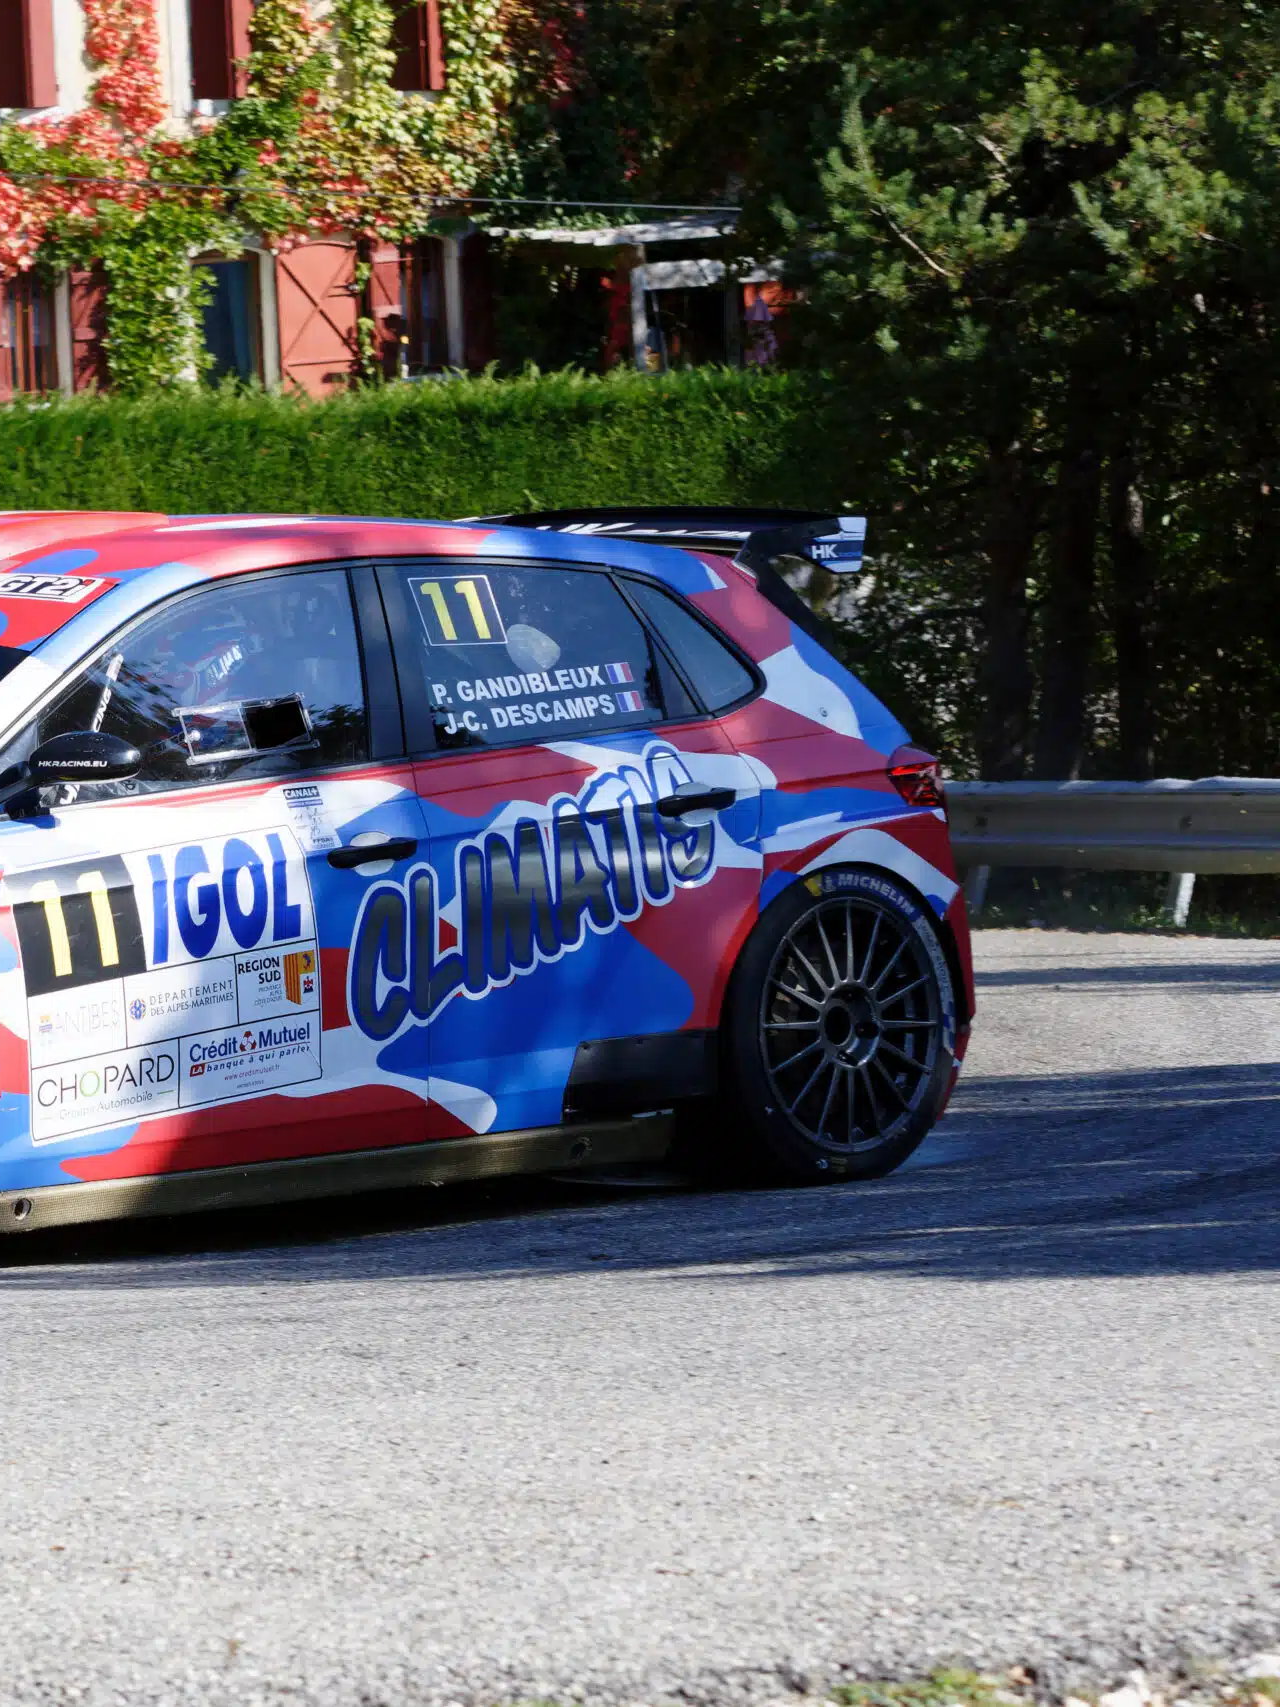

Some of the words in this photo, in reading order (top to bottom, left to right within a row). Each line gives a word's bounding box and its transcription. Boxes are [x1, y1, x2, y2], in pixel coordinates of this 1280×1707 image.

[811, 543, 839, 560] HK
[420, 579, 492, 641] 11
[432, 683, 453, 705] P.
[456, 665, 607, 702] GANDIBLEUX
[444, 712, 489, 735] J-C.
[490, 694, 616, 729] DESCAMPS
[38, 759, 108, 769] HKRACING.EU
[284, 787, 318, 799] CANAL+
[147, 832, 302, 966] IGOL
[347, 739, 720, 1041] CLIMATIS
[837, 873, 916, 916] MICHELIN
[29, 870, 120, 978] 11
[258, 969, 282, 985] SUD
[150, 1004, 165, 1016] DES
[167, 991, 235, 1013] ALPES-MARITIMES
[189, 1036, 238, 1063] Crédit
[258, 1022, 310, 1049] Mutuel
[206, 1058, 245, 1073] banque
[258, 1050, 275, 1062] qui
[279, 1044, 310, 1059] parler
[37, 1053, 175, 1107] CHOPARD
[98, 1090, 153, 1111] Automobile
